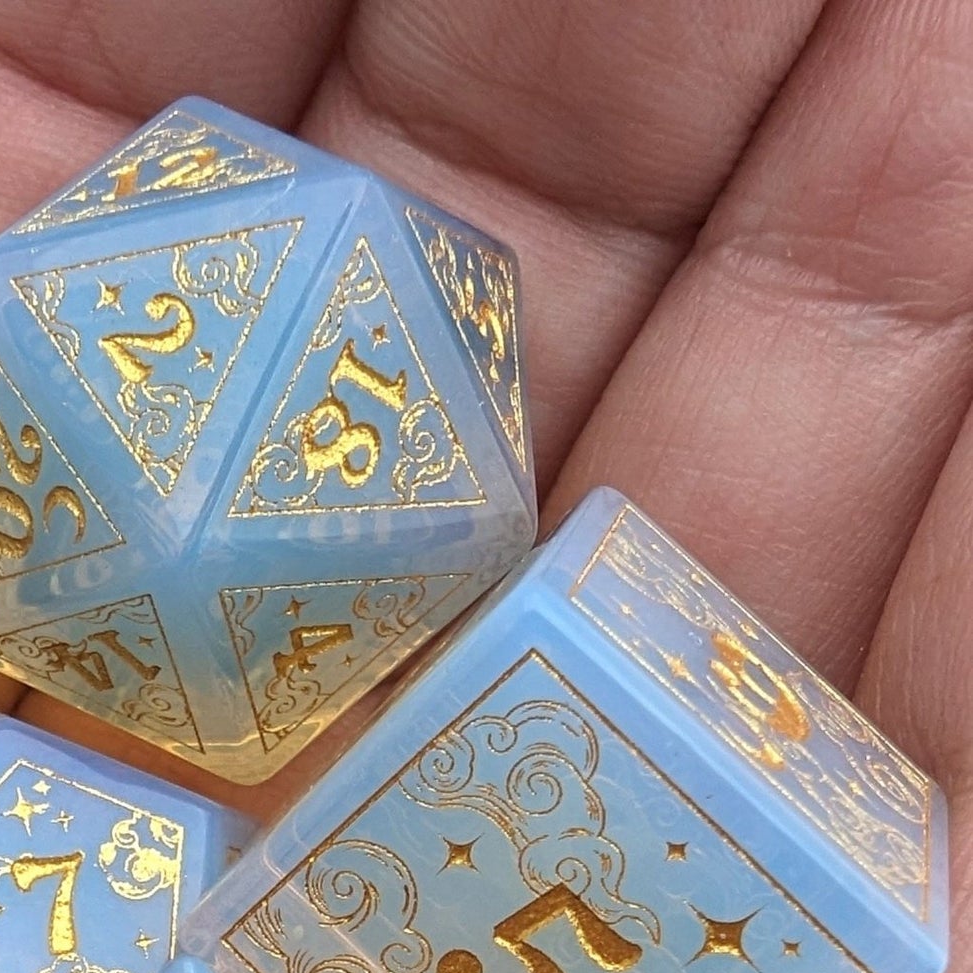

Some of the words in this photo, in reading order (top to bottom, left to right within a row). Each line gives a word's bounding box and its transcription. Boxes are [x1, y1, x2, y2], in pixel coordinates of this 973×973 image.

[101, 146, 219, 202] 12
[98, 293, 195, 384] 2
[303, 339, 407, 486] 18
[45, 630, 161, 692] 14
[273, 624, 354, 678] 4
[11, 850, 85, 957] 7
